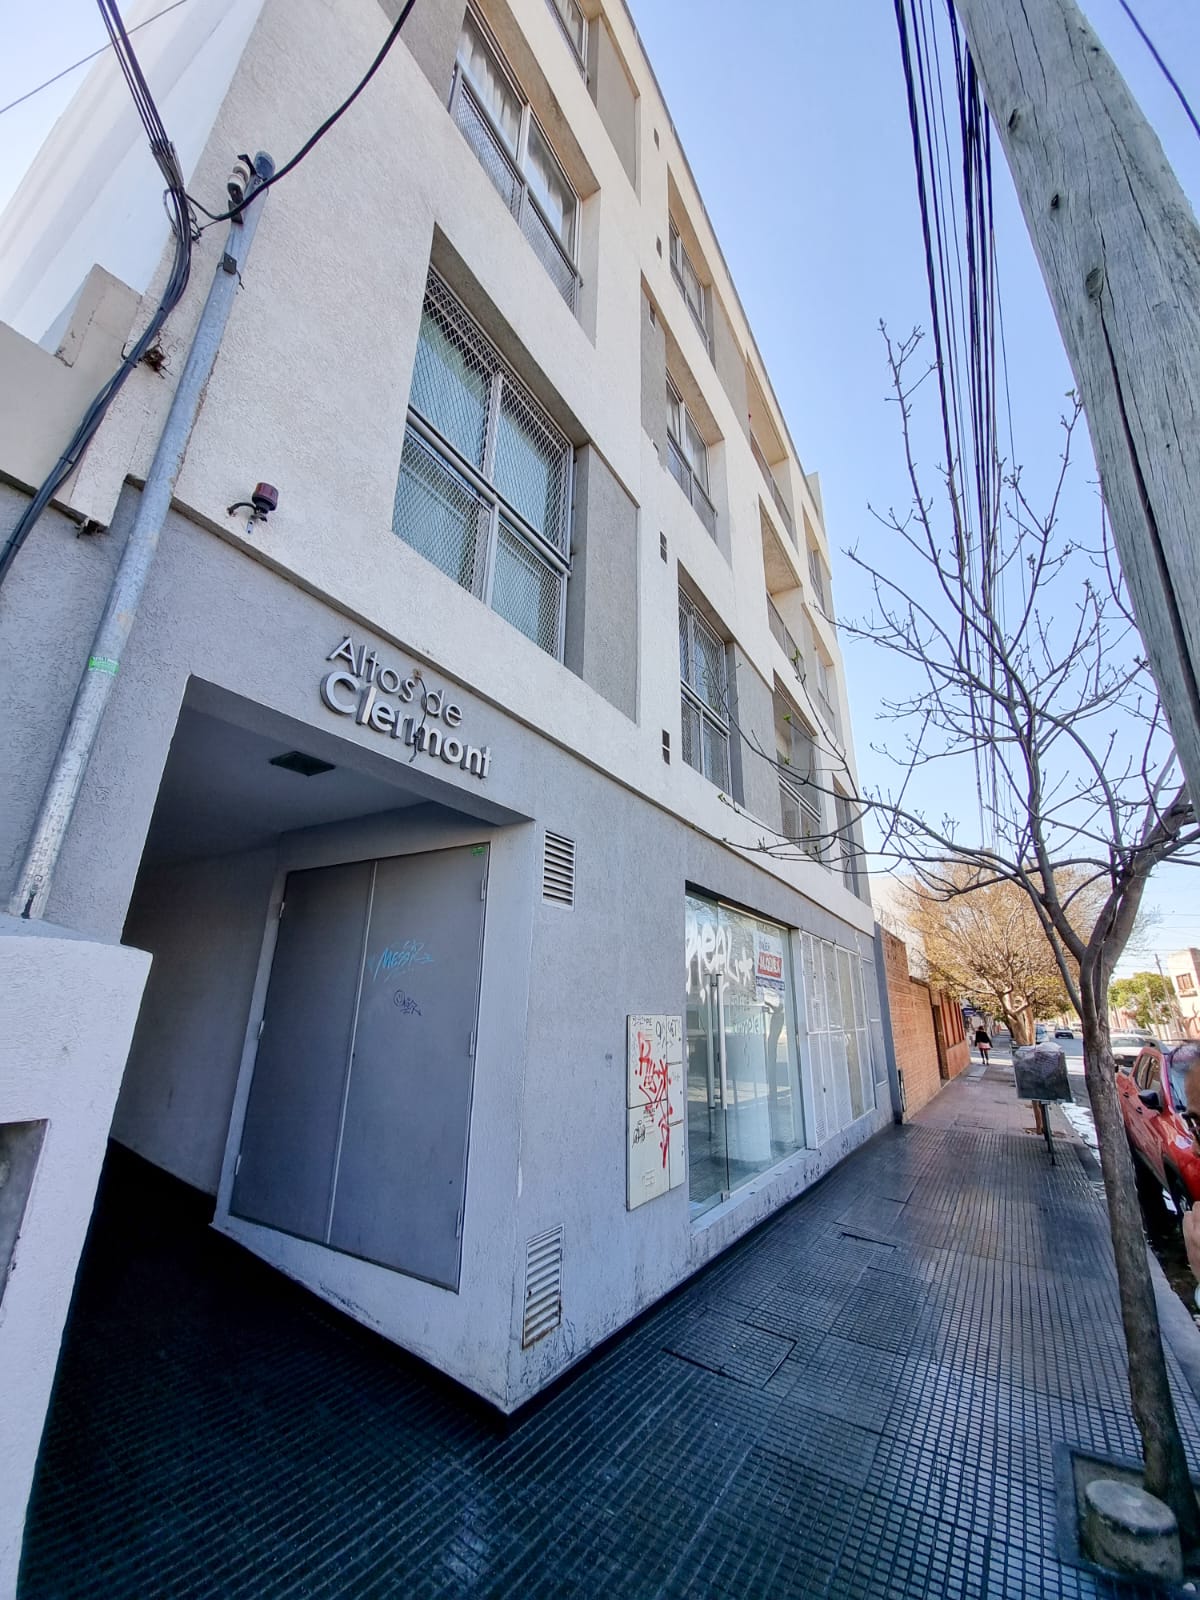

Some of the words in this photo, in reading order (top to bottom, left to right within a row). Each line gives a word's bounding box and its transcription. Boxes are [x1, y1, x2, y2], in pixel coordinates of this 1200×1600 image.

[320, 671, 492, 779] Clermont
[326, 636, 415, 703] Altos
[421, 689, 463, 727] de
